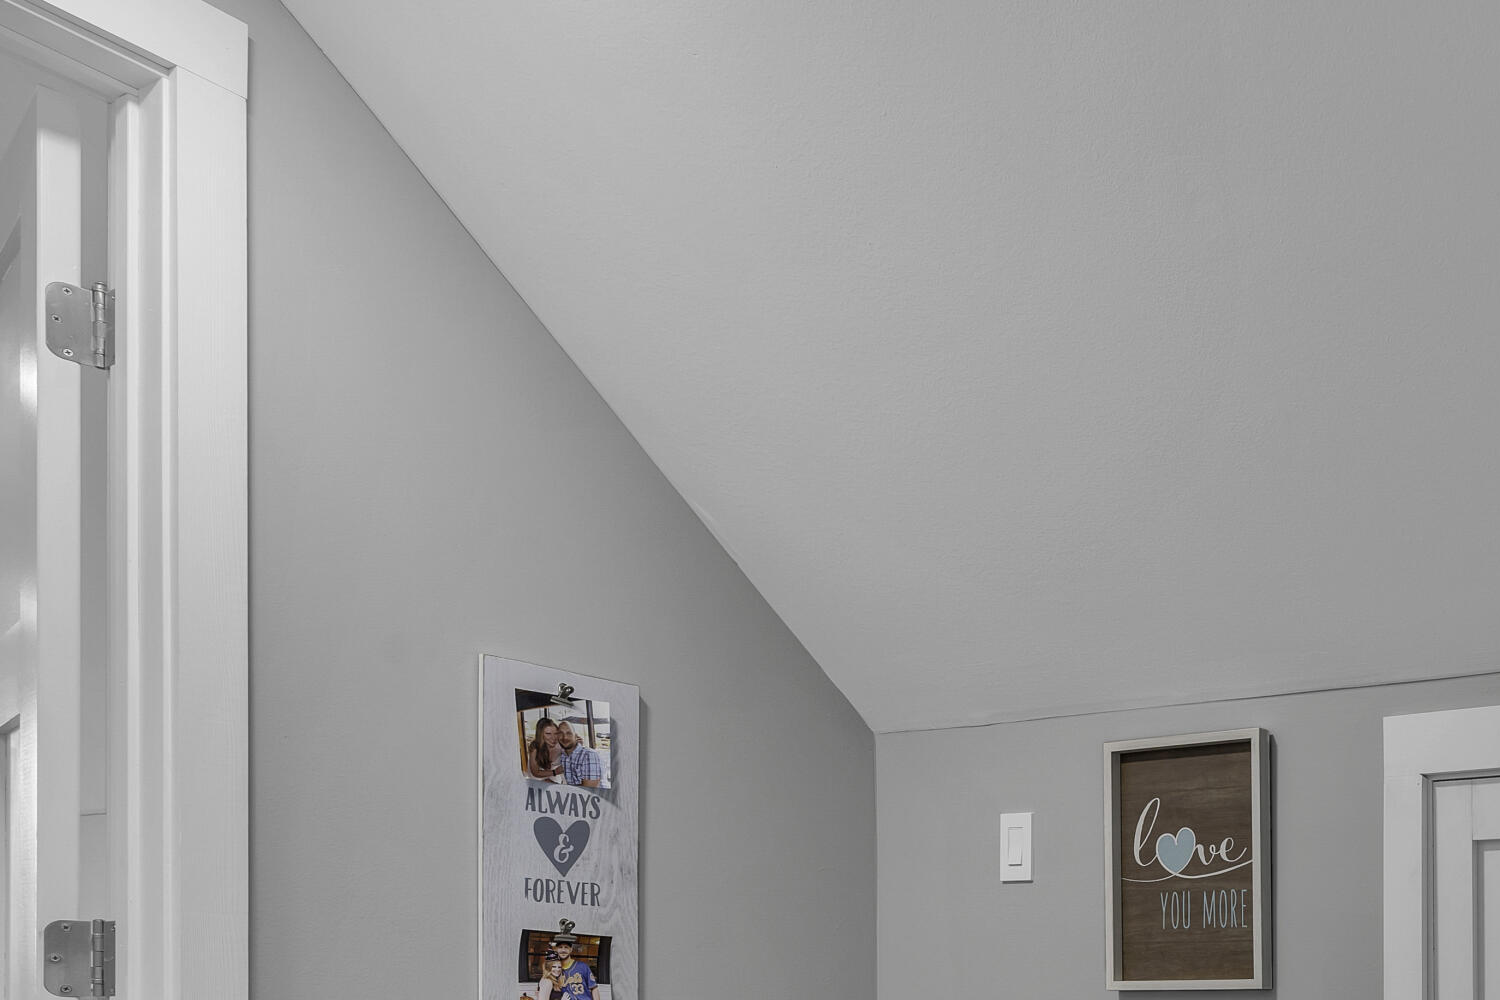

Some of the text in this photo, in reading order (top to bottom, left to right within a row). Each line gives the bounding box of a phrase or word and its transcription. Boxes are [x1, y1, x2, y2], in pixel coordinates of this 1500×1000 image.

[525, 787, 600, 820] ALWAYS
[554, 833, 574, 864] &
[524, 878, 600, 906] FOREVER
[1160, 889, 1248, 930] YOU MORE
